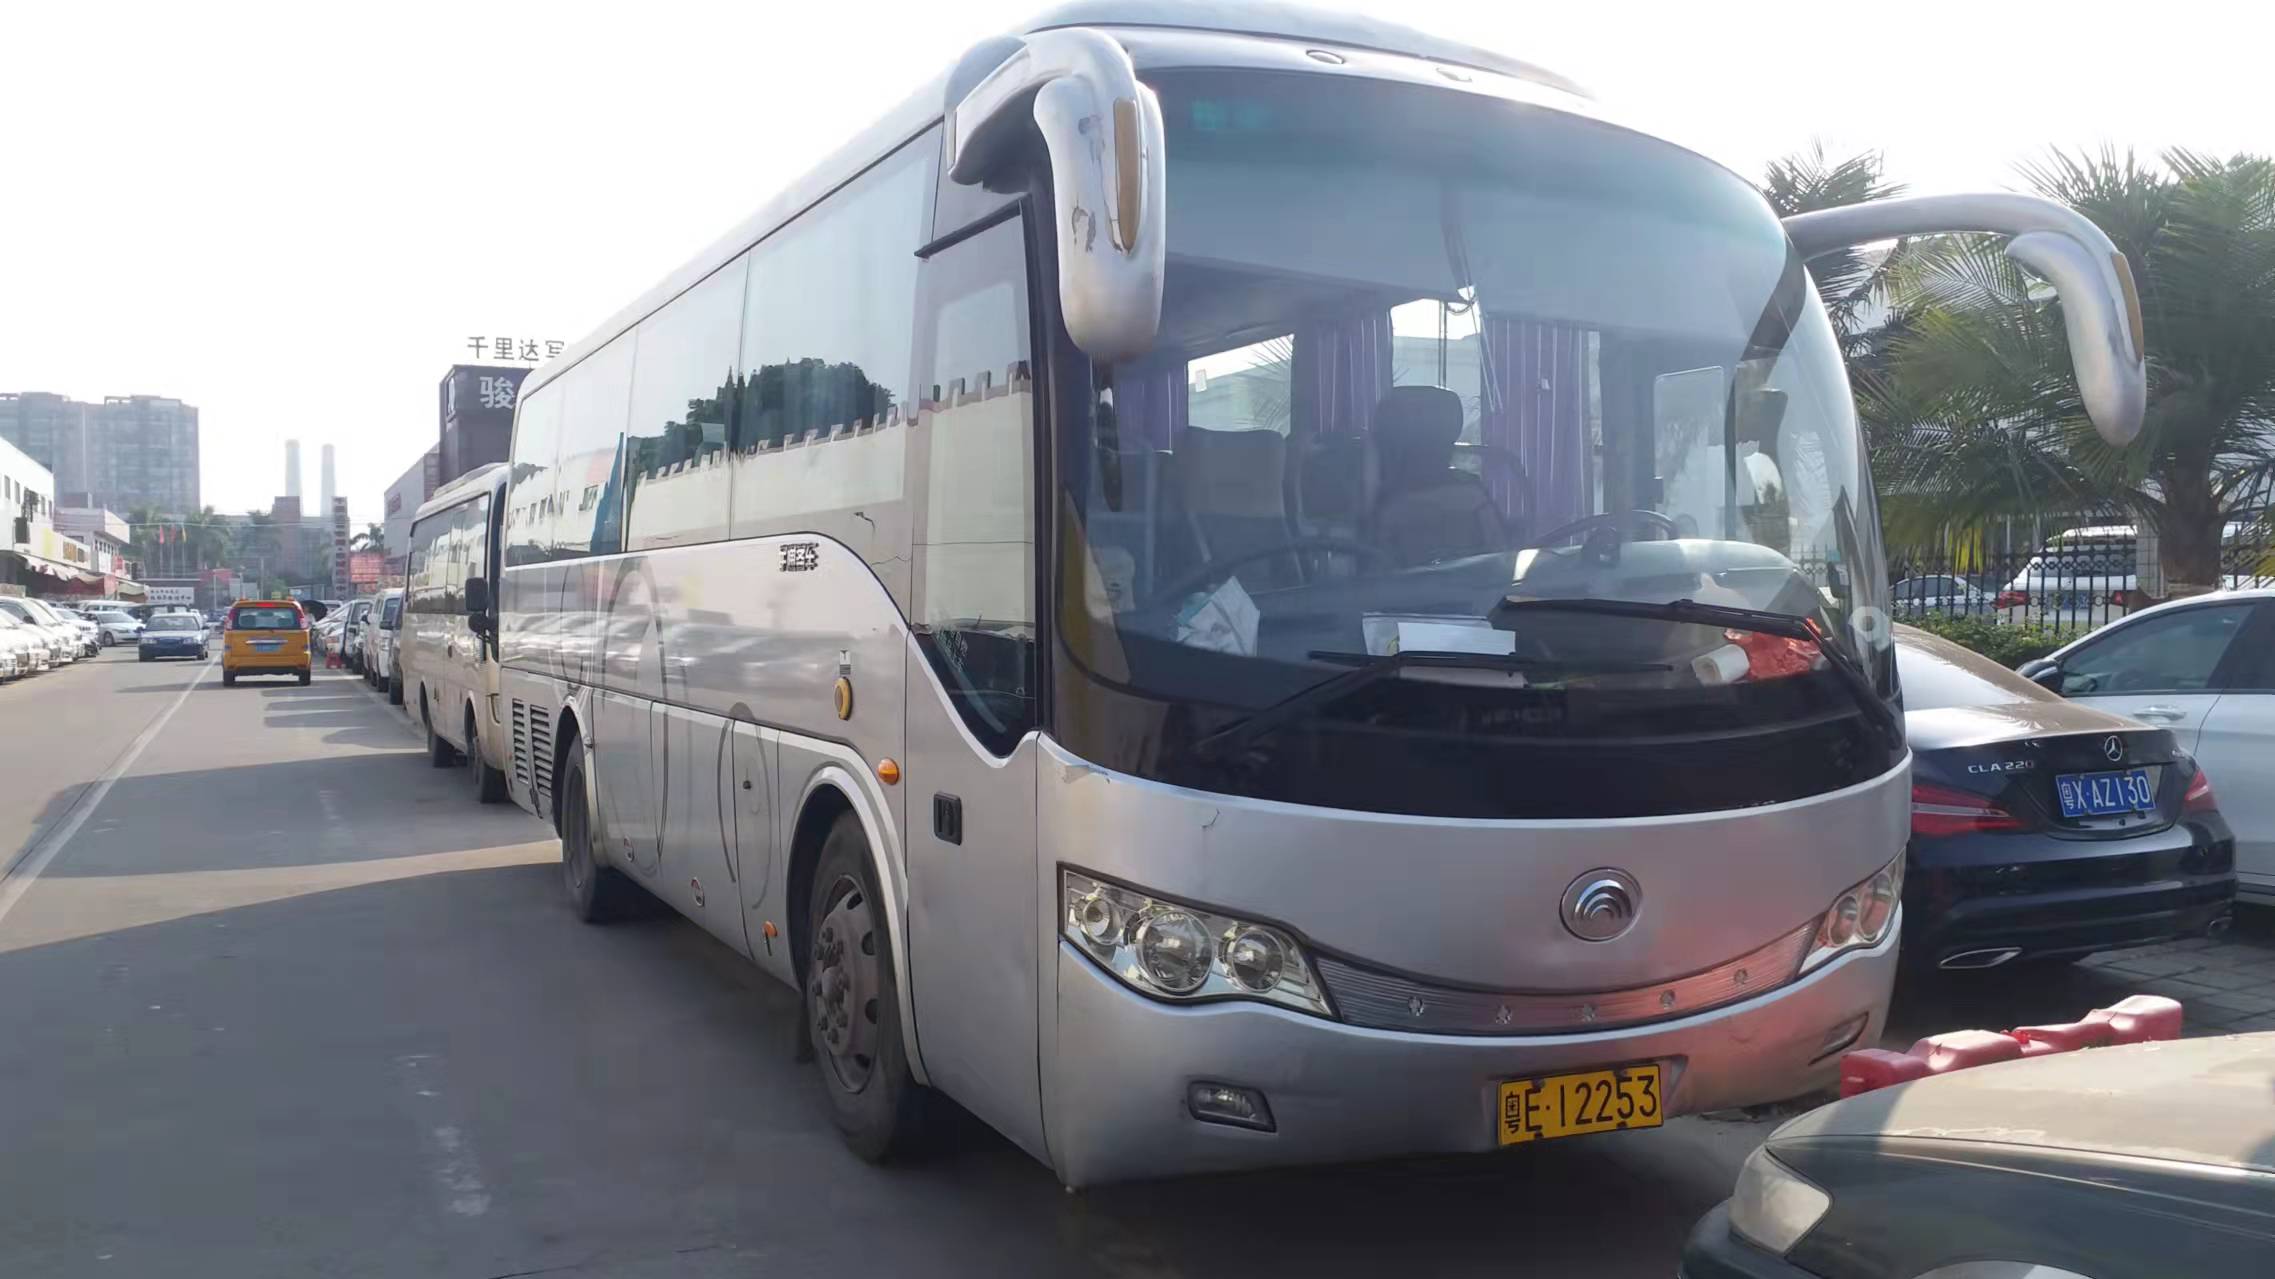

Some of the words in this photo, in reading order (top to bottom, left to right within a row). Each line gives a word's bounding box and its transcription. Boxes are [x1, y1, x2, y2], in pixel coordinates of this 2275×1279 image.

[480, 376, 516, 410] 骏
[1967, 763, 2001, 774] CLA
[2004, 760, 2034, 771] 220
